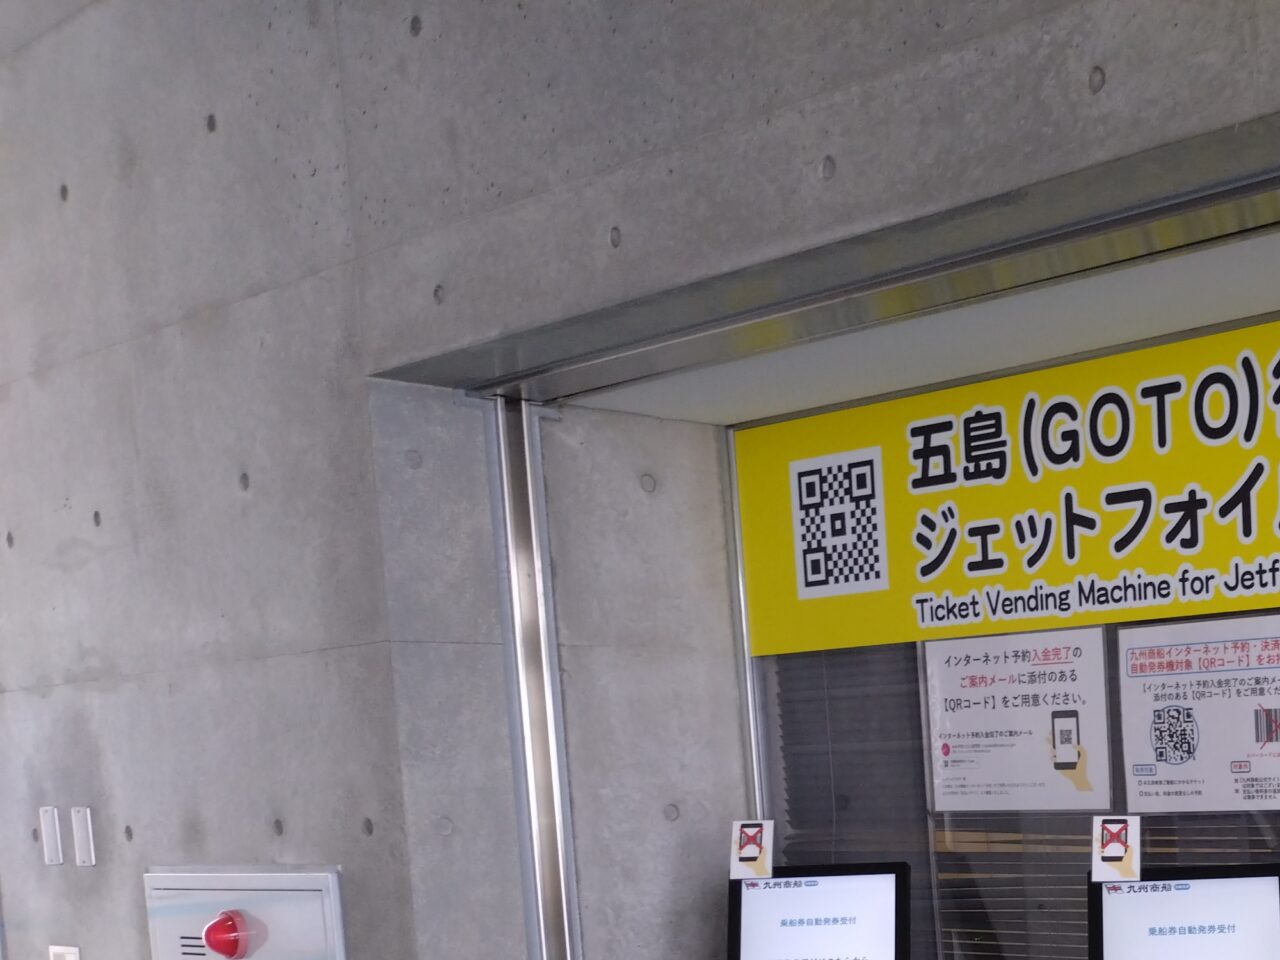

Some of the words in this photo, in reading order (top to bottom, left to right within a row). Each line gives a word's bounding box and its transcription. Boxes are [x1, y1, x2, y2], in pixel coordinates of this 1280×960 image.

[916, 594, 981, 624] Ticket
[985, 584, 1072, 617] Vending
[1077, 574, 1172, 609] Machine
[1177, 570, 1215, 597] for
[944, 646, 1083, 668] インターネット予約入金完了の
[959, 669, 1078, 689] ご案内メールに添付のある
[1148, 924, 1236, 936] 乗船券自動発券受付
